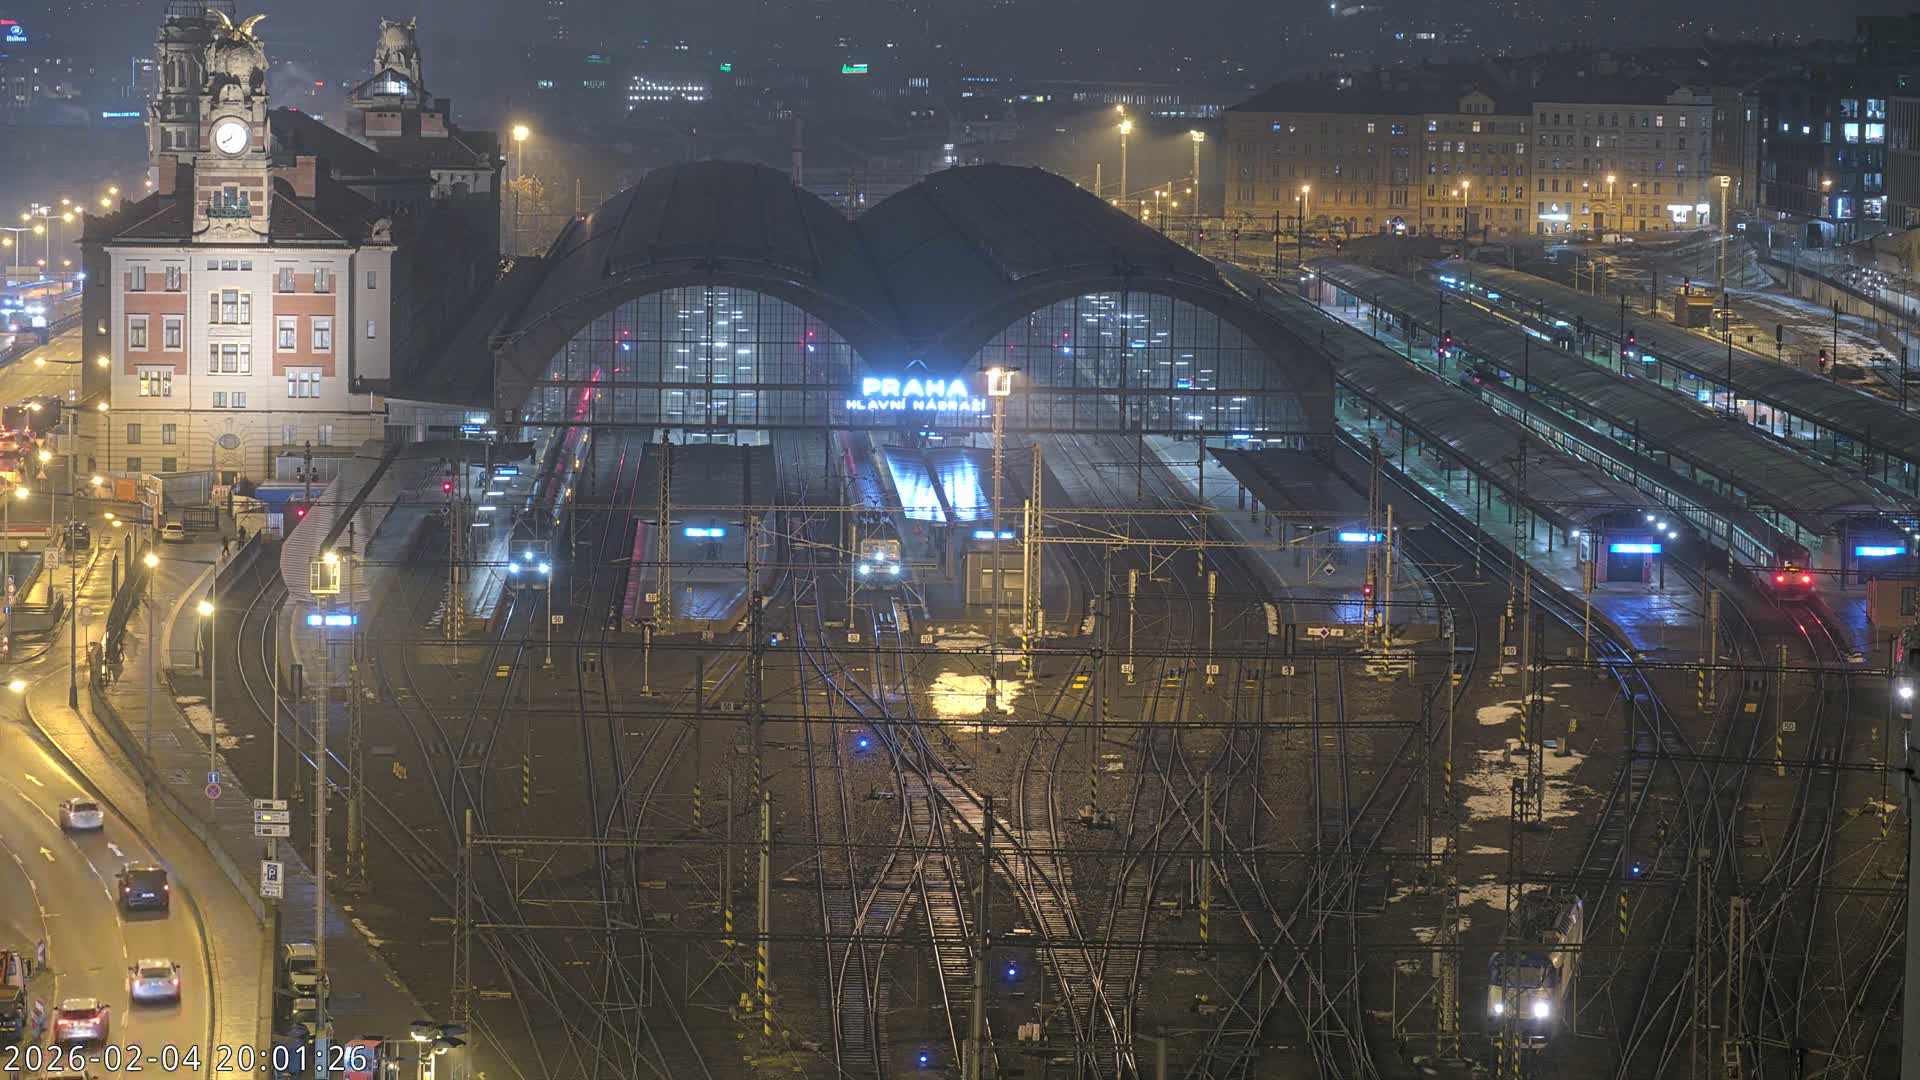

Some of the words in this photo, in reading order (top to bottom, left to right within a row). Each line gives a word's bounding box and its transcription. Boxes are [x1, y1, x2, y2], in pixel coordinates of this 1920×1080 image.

[863, 377, 968, 397] PRAHA
[846, 398, 906, 410] HLAVNÍ
[912, 398, 986, 411] NÁDRAŽÍ
